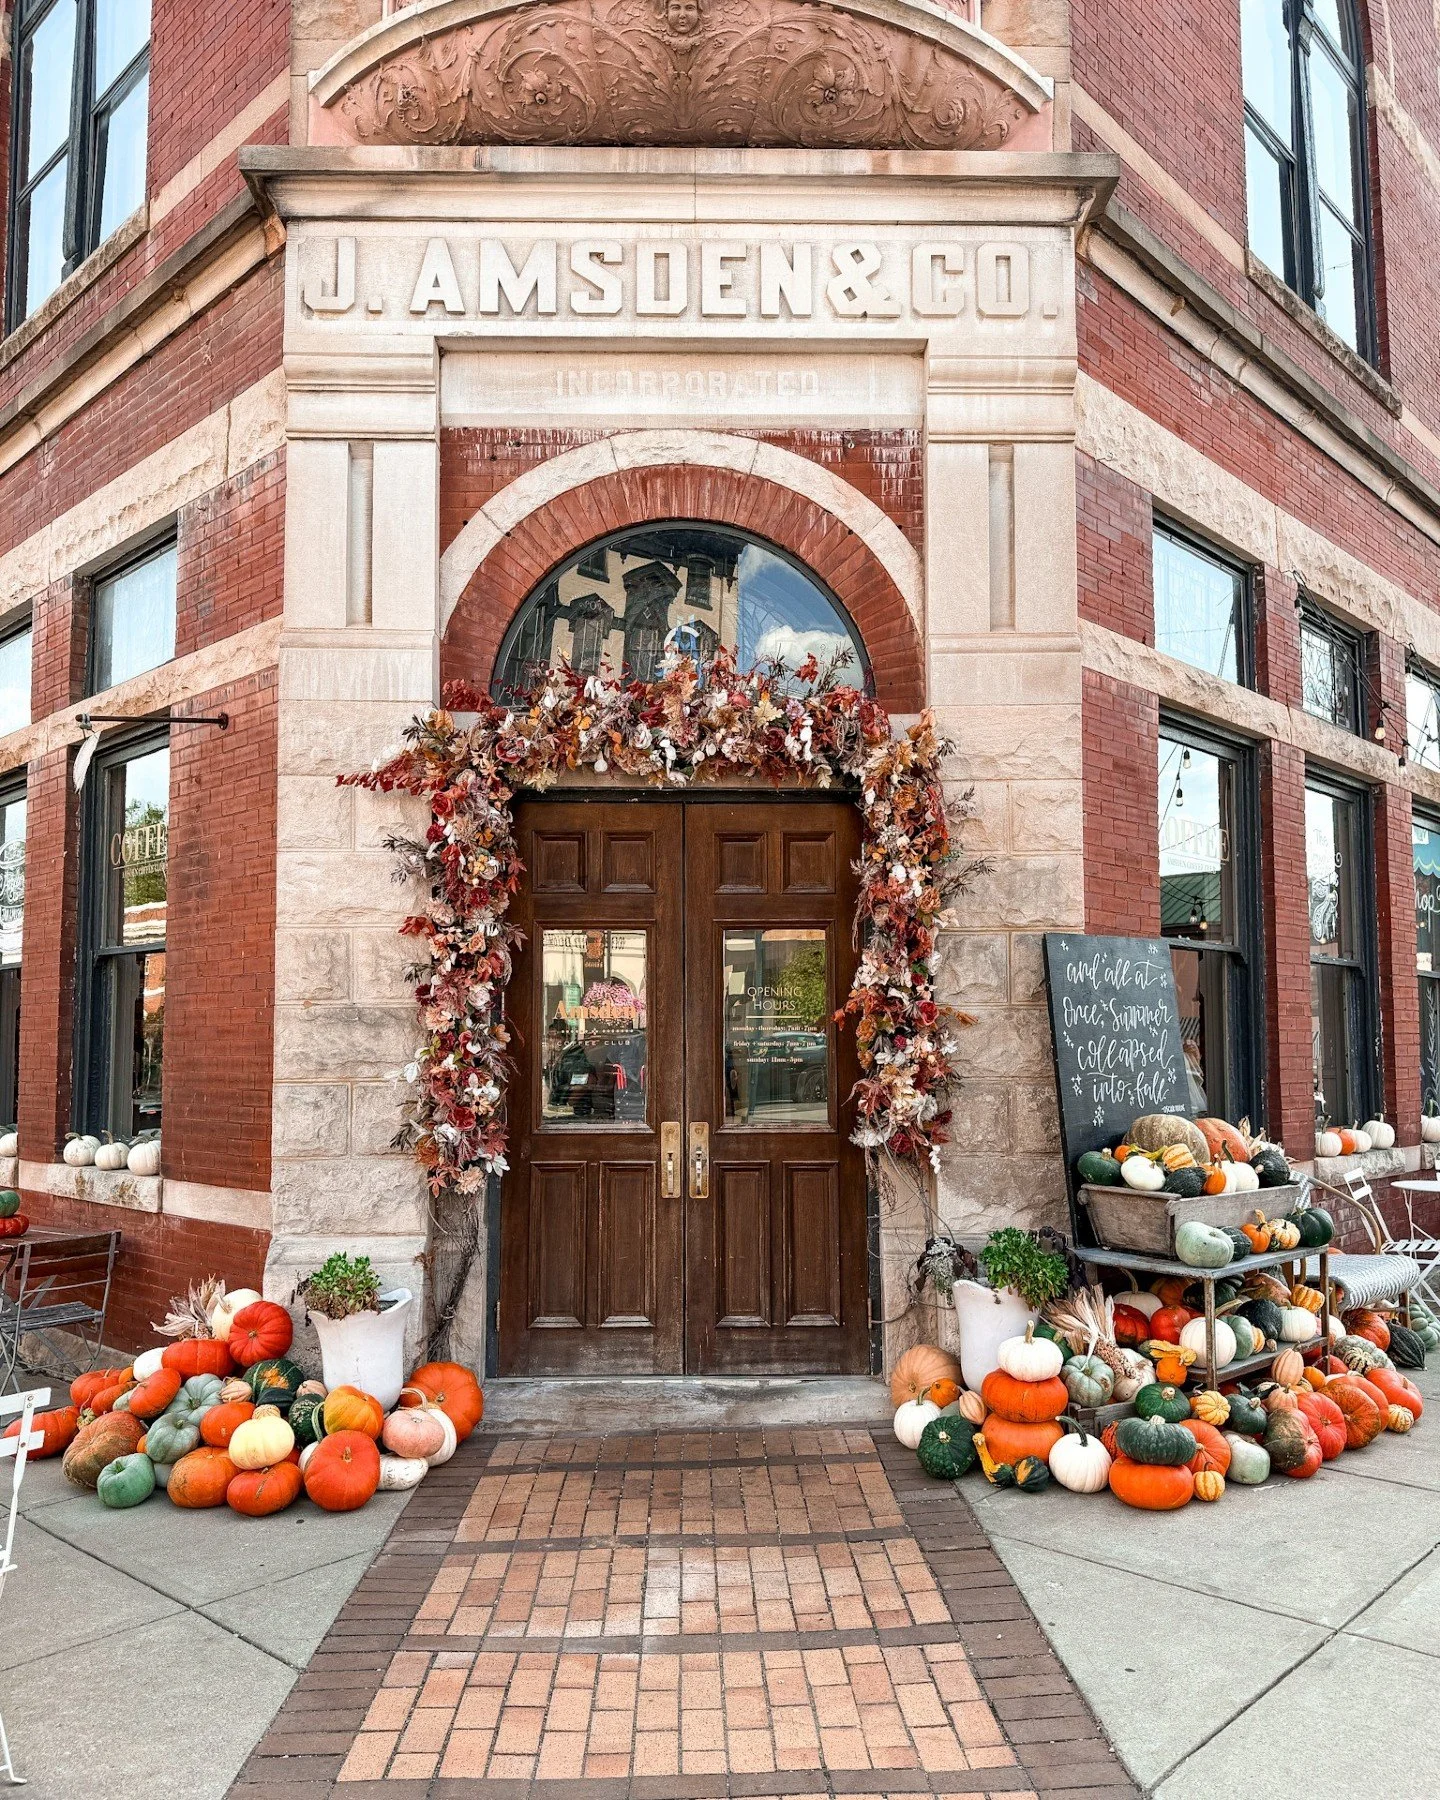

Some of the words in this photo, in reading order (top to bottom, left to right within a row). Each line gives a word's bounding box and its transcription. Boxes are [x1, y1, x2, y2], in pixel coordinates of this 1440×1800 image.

[303, 236, 383, 314] J.
[409, 237, 812, 318] AMSDEN
[827, 241, 901, 318] &
[912, 241, 1059, 320] CO.
[555, 369, 819, 397] INCORPORATED
[111, 823, 168, 866] COFFE
[1161, 816, 1230, 862] OFFEE
[1067, 953, 1102, 990] and
[1104, 958, 1132, 990] all
[1133, 960, 1164, 990] at
[747, 986, 803, 997] OPENING
[753, 1000, 796, 1011] HOURS
[552, 999, 637, 1020] Amsden
[1077, 1029, 1174, 1072] collapsed
[1087, 1072, 1132, 1104] into
